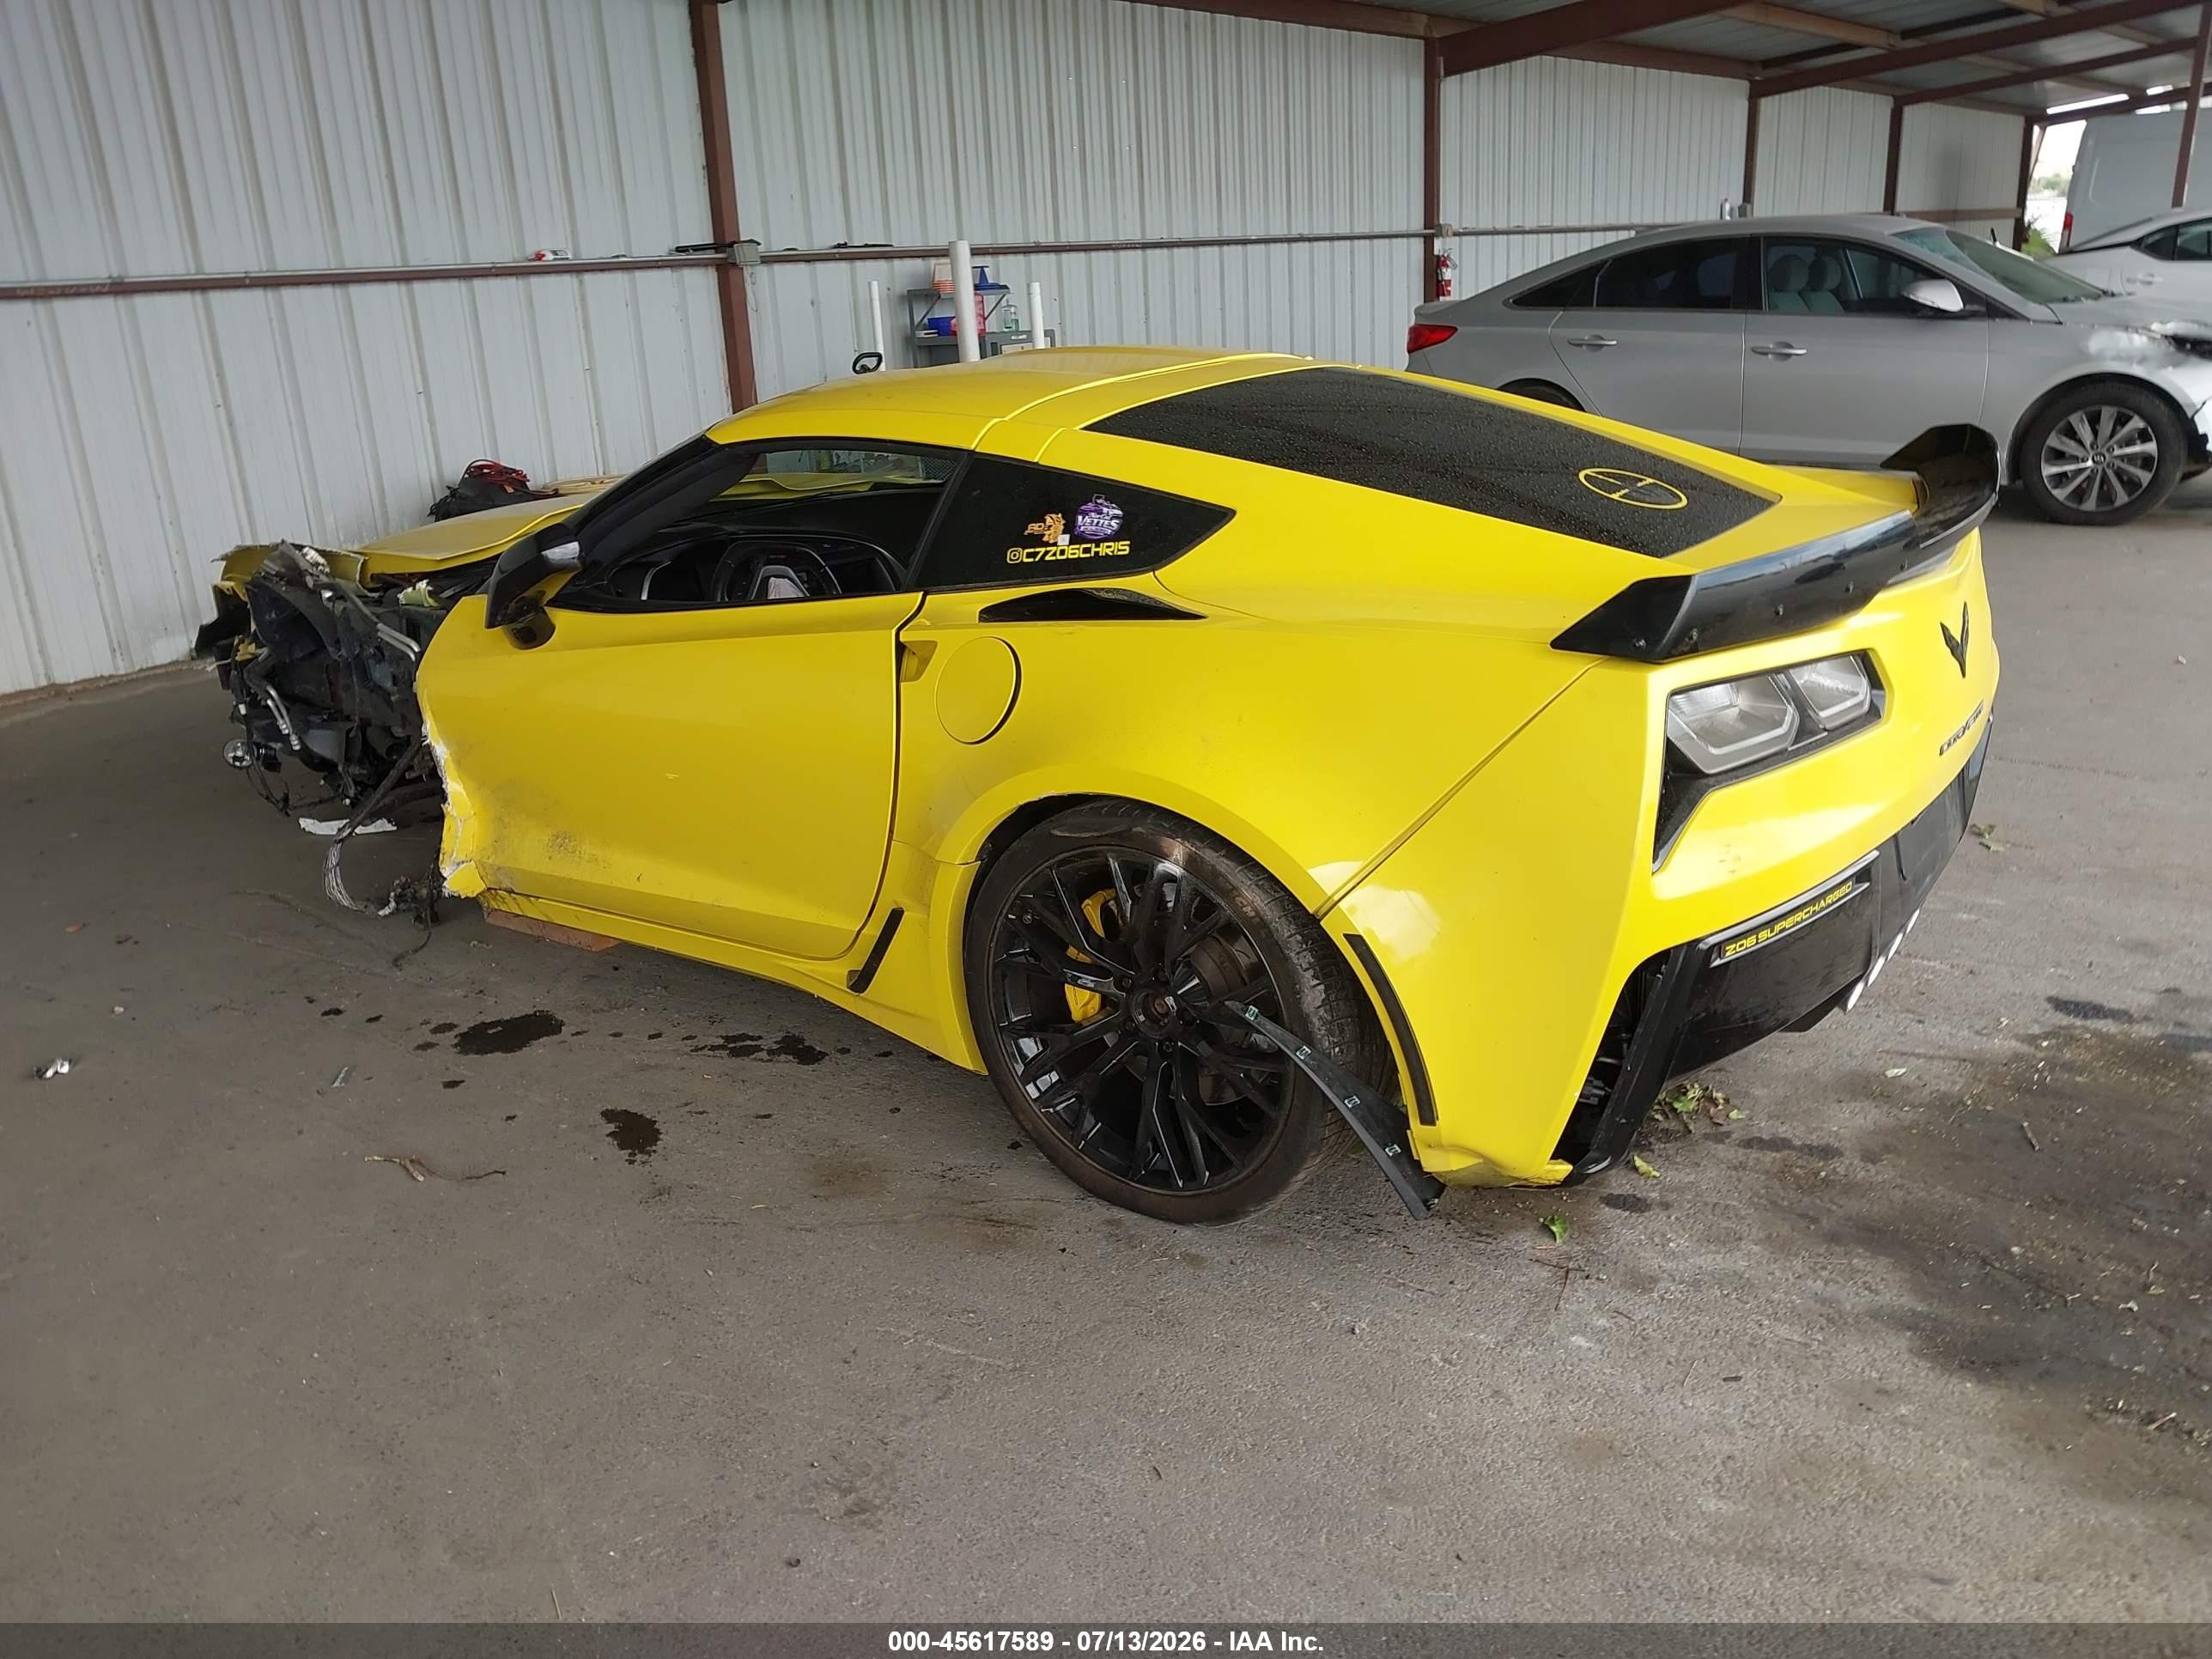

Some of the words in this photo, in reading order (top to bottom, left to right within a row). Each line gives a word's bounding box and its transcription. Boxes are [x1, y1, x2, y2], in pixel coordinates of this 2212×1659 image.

[1077, 515, 1121, 531] VETTES
[1724, 933, 1757, 957] Z06
[1757, 880, 1853, 942] SUPERCHARGED
